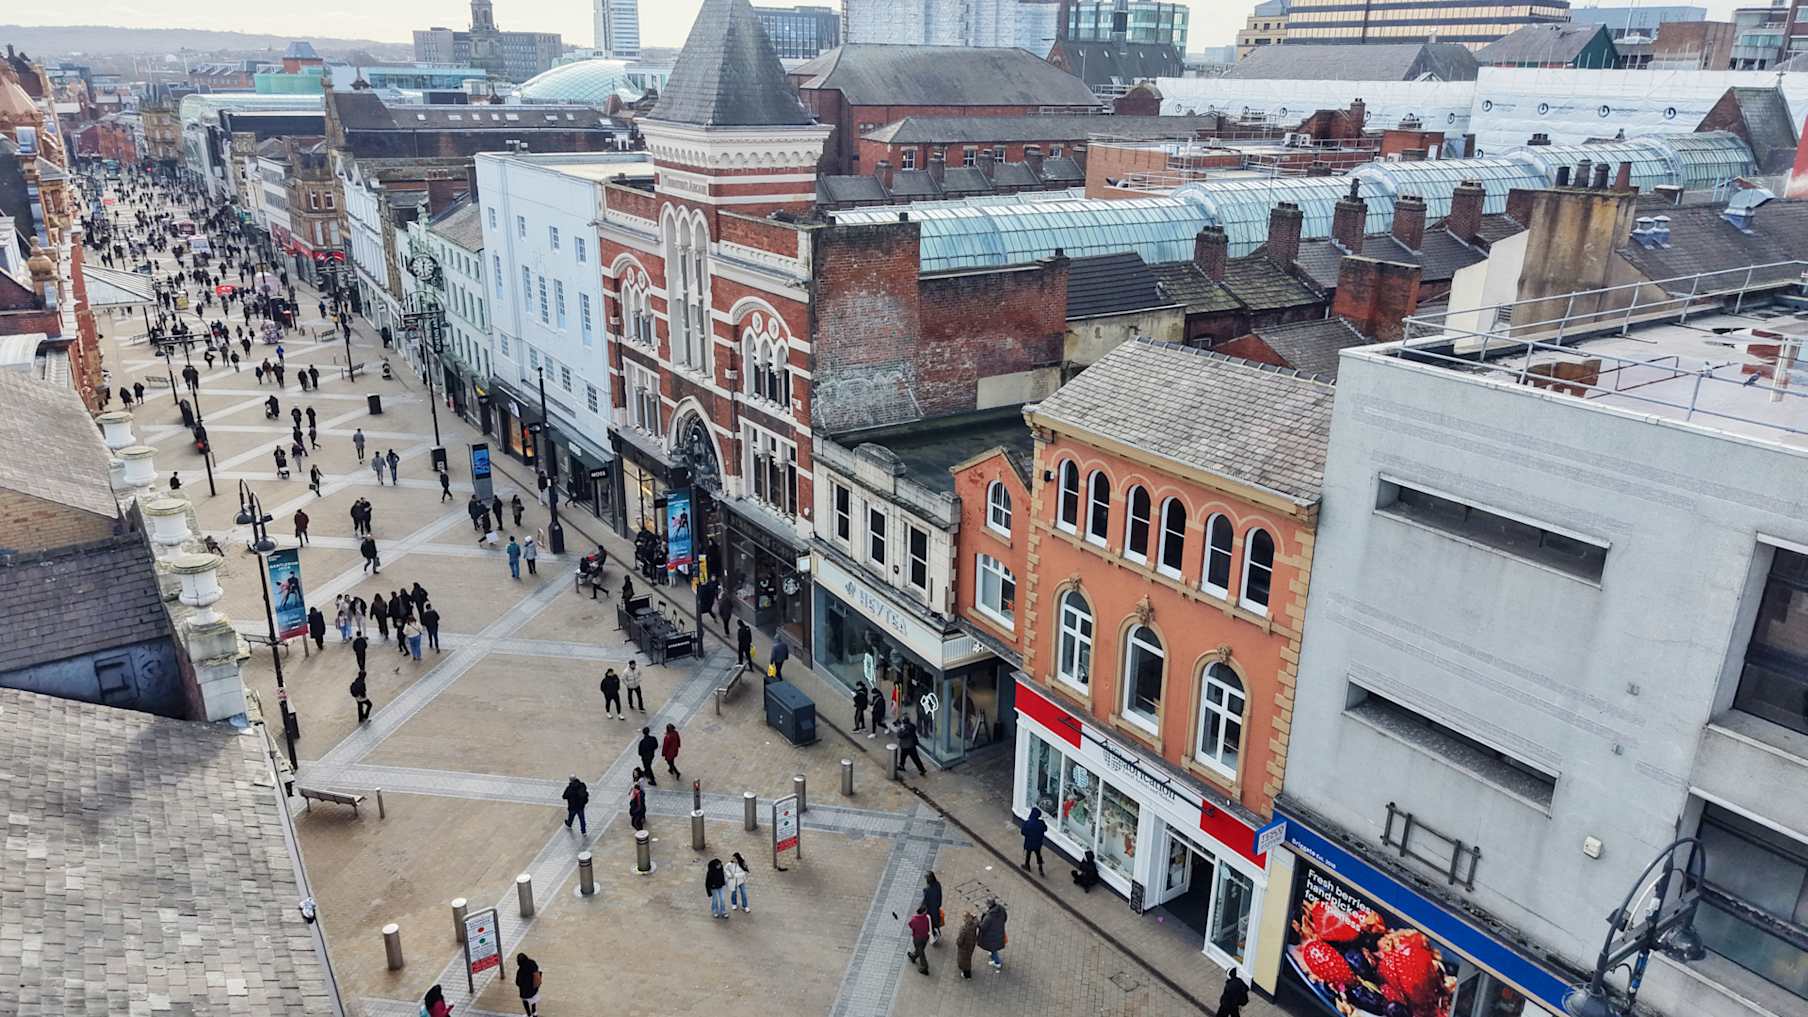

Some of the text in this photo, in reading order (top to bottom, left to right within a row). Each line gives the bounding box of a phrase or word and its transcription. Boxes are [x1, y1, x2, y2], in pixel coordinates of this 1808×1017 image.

[1260, 826, 1284, 842] TESCO
[1308, 868, 1334, 892] Fresh
[1305, 890, 1361, 932] for ripeness
[1306, 879, 1367, 923] handpicked
